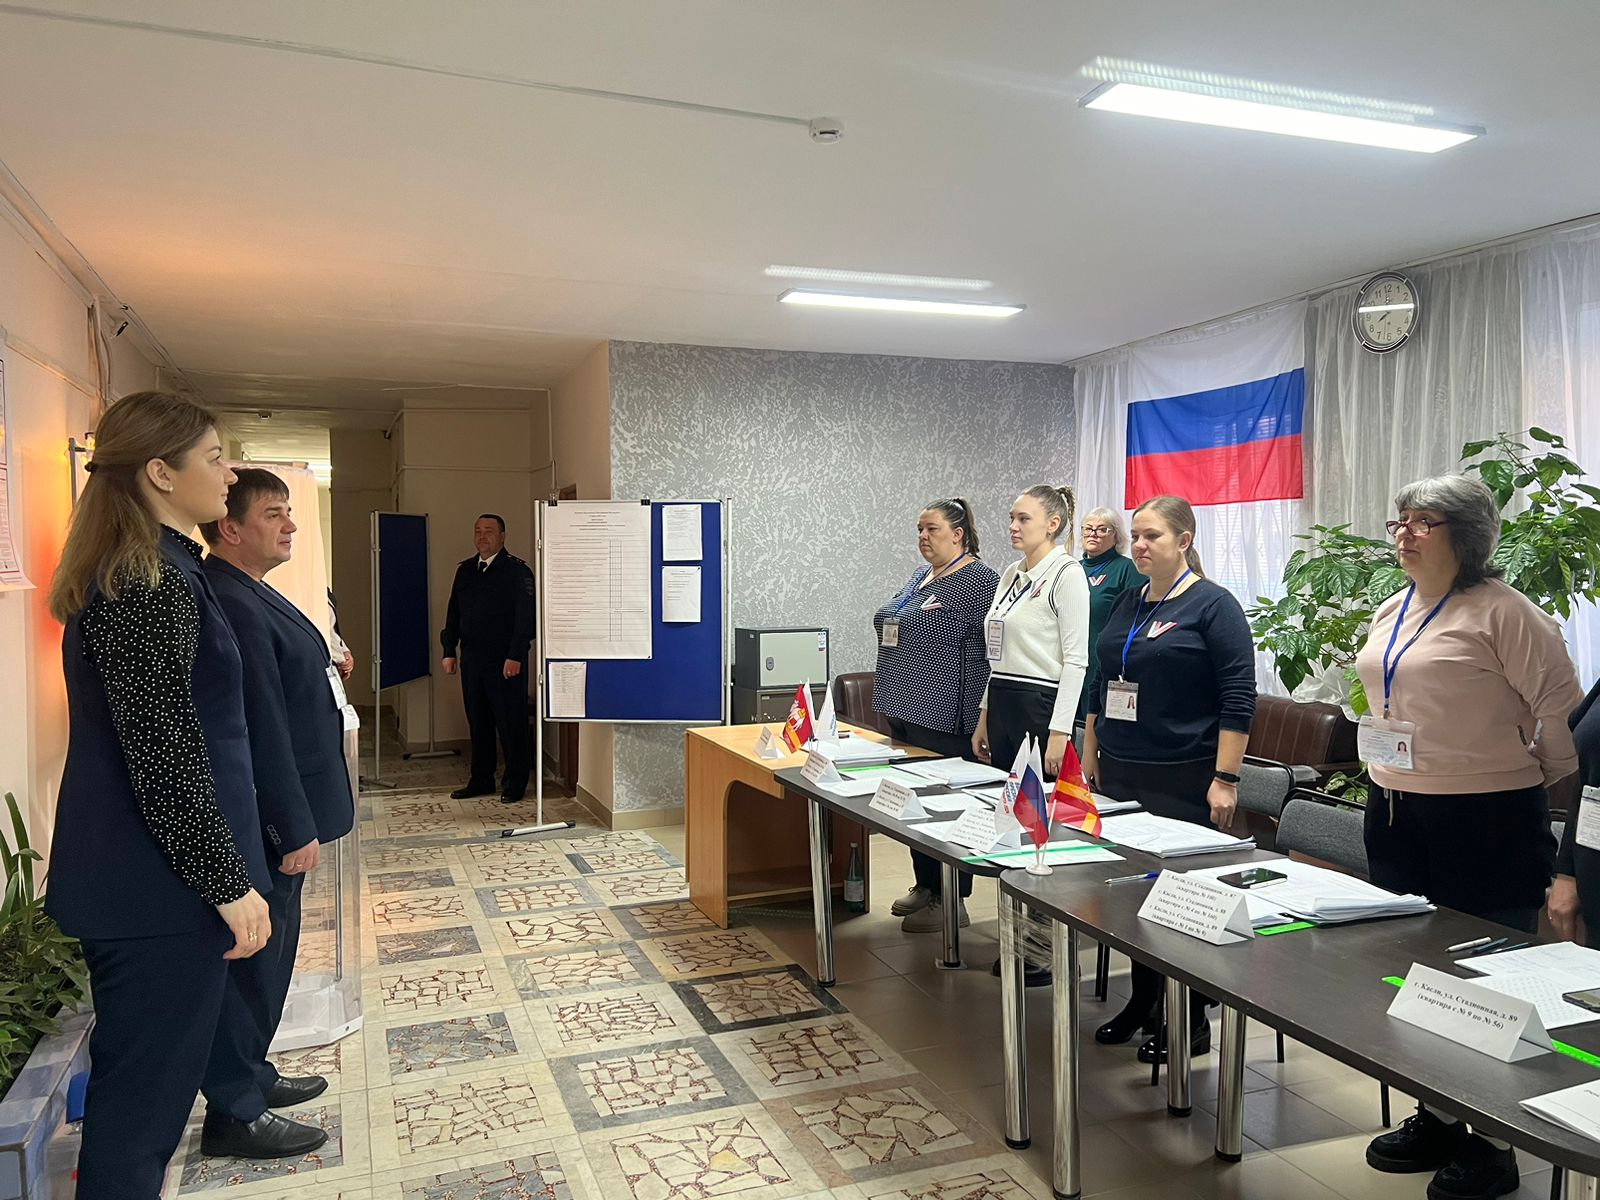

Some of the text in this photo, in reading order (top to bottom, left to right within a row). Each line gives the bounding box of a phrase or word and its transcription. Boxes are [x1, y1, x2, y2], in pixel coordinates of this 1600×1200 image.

[1384, 284, 1392, 293] 12
[1375, 289, 1382, 299] 11
[1403, 291, 1409, 301] 2
[1366, 313, 1371, 321] 9
[1403, 316, 1409, 324] 4
[1369, 324, 1375, 333] 8
[1397, 327, 1402, 335] 5
[1377, 331, 1382, 340] 7
[1387, 332, 1392, 341] 6
[1420, 983, 1443, 997] Касли,
[1443, 992, 1454, 1000] ул.
[1455, 995, 1499, 1017] Стадионная,
[1508, 1013, 1518, 1022] 89
[1417, 993, 1452, 1010] (квартира
[1457, 1007, 1466, 1015] №
[1481, 1016, 1491, 1025] №
[1492, 1020, 1504, 1030] 56)
